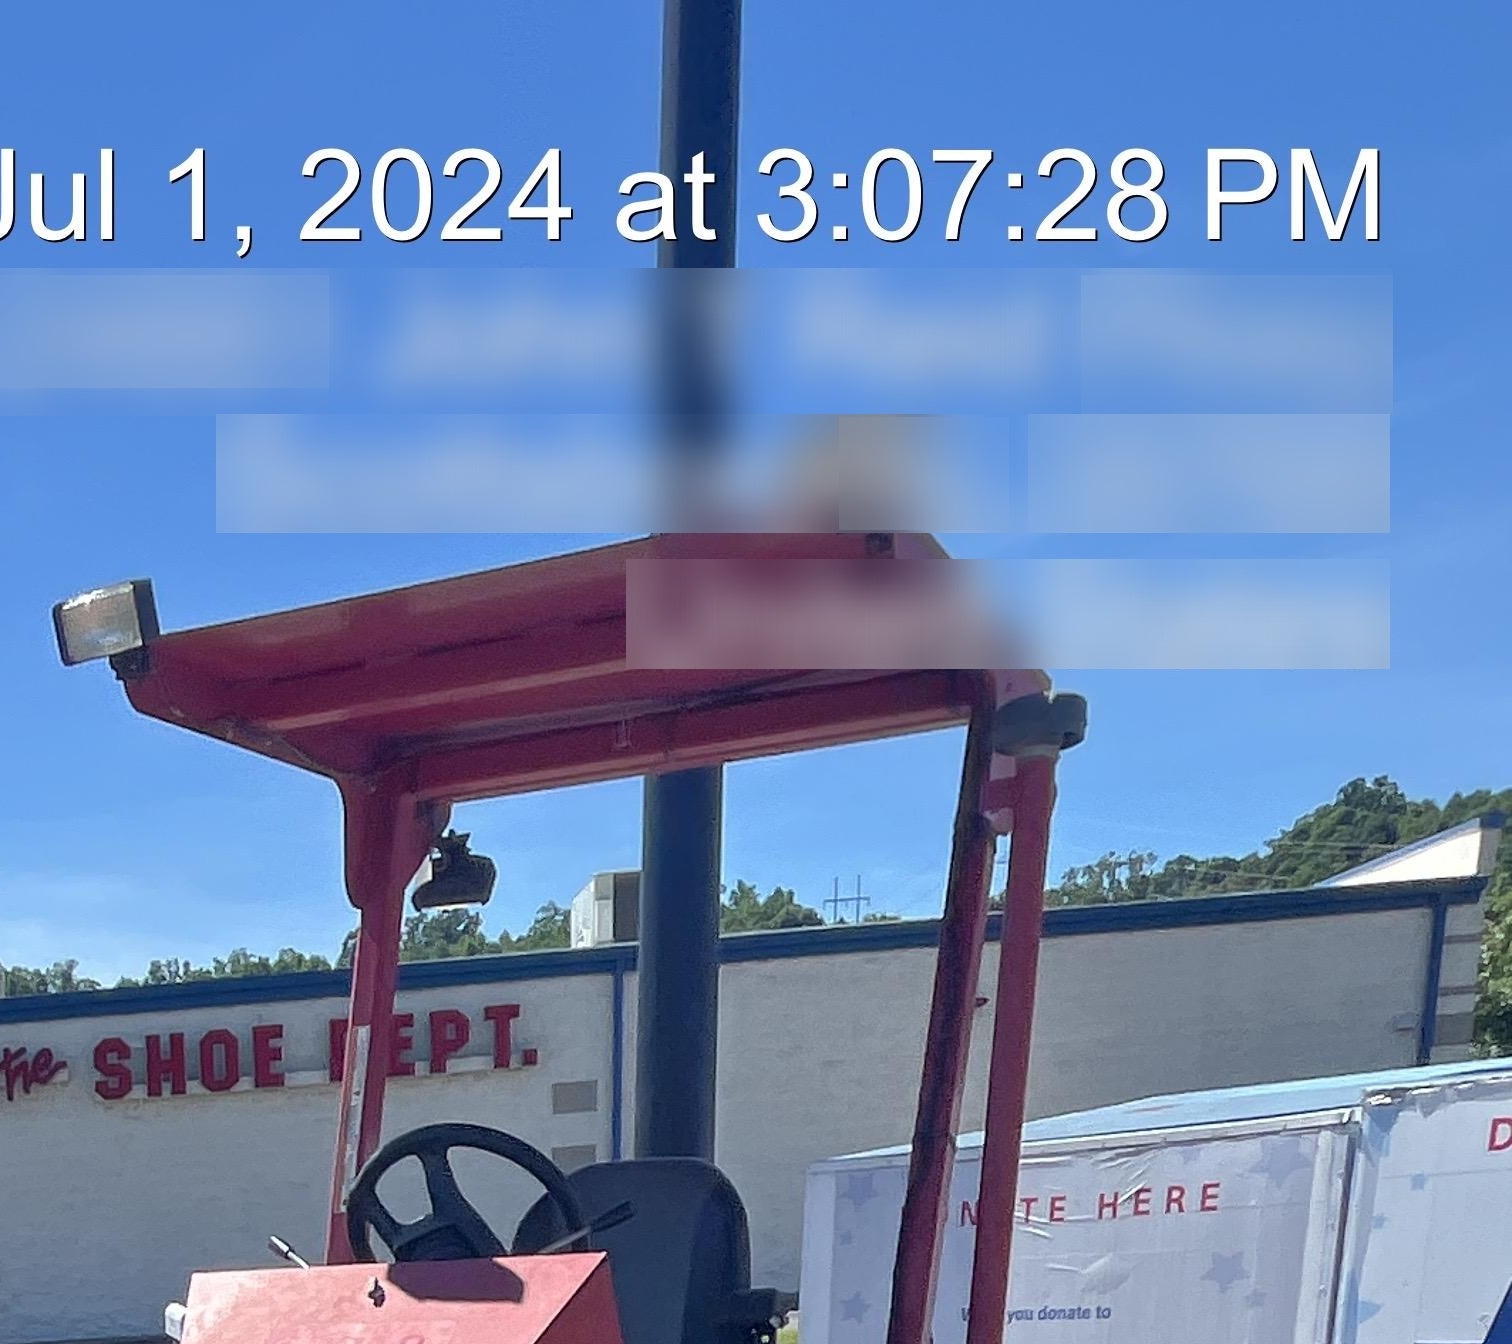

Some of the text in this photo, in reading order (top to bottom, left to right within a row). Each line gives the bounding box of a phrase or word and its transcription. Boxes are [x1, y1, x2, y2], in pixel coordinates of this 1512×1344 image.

[93, 1024, 285, 1101] SHOE
[1097, 1183, 1221, 1220] HERE
[1007, 1305, 1112, 1325] you donate to
